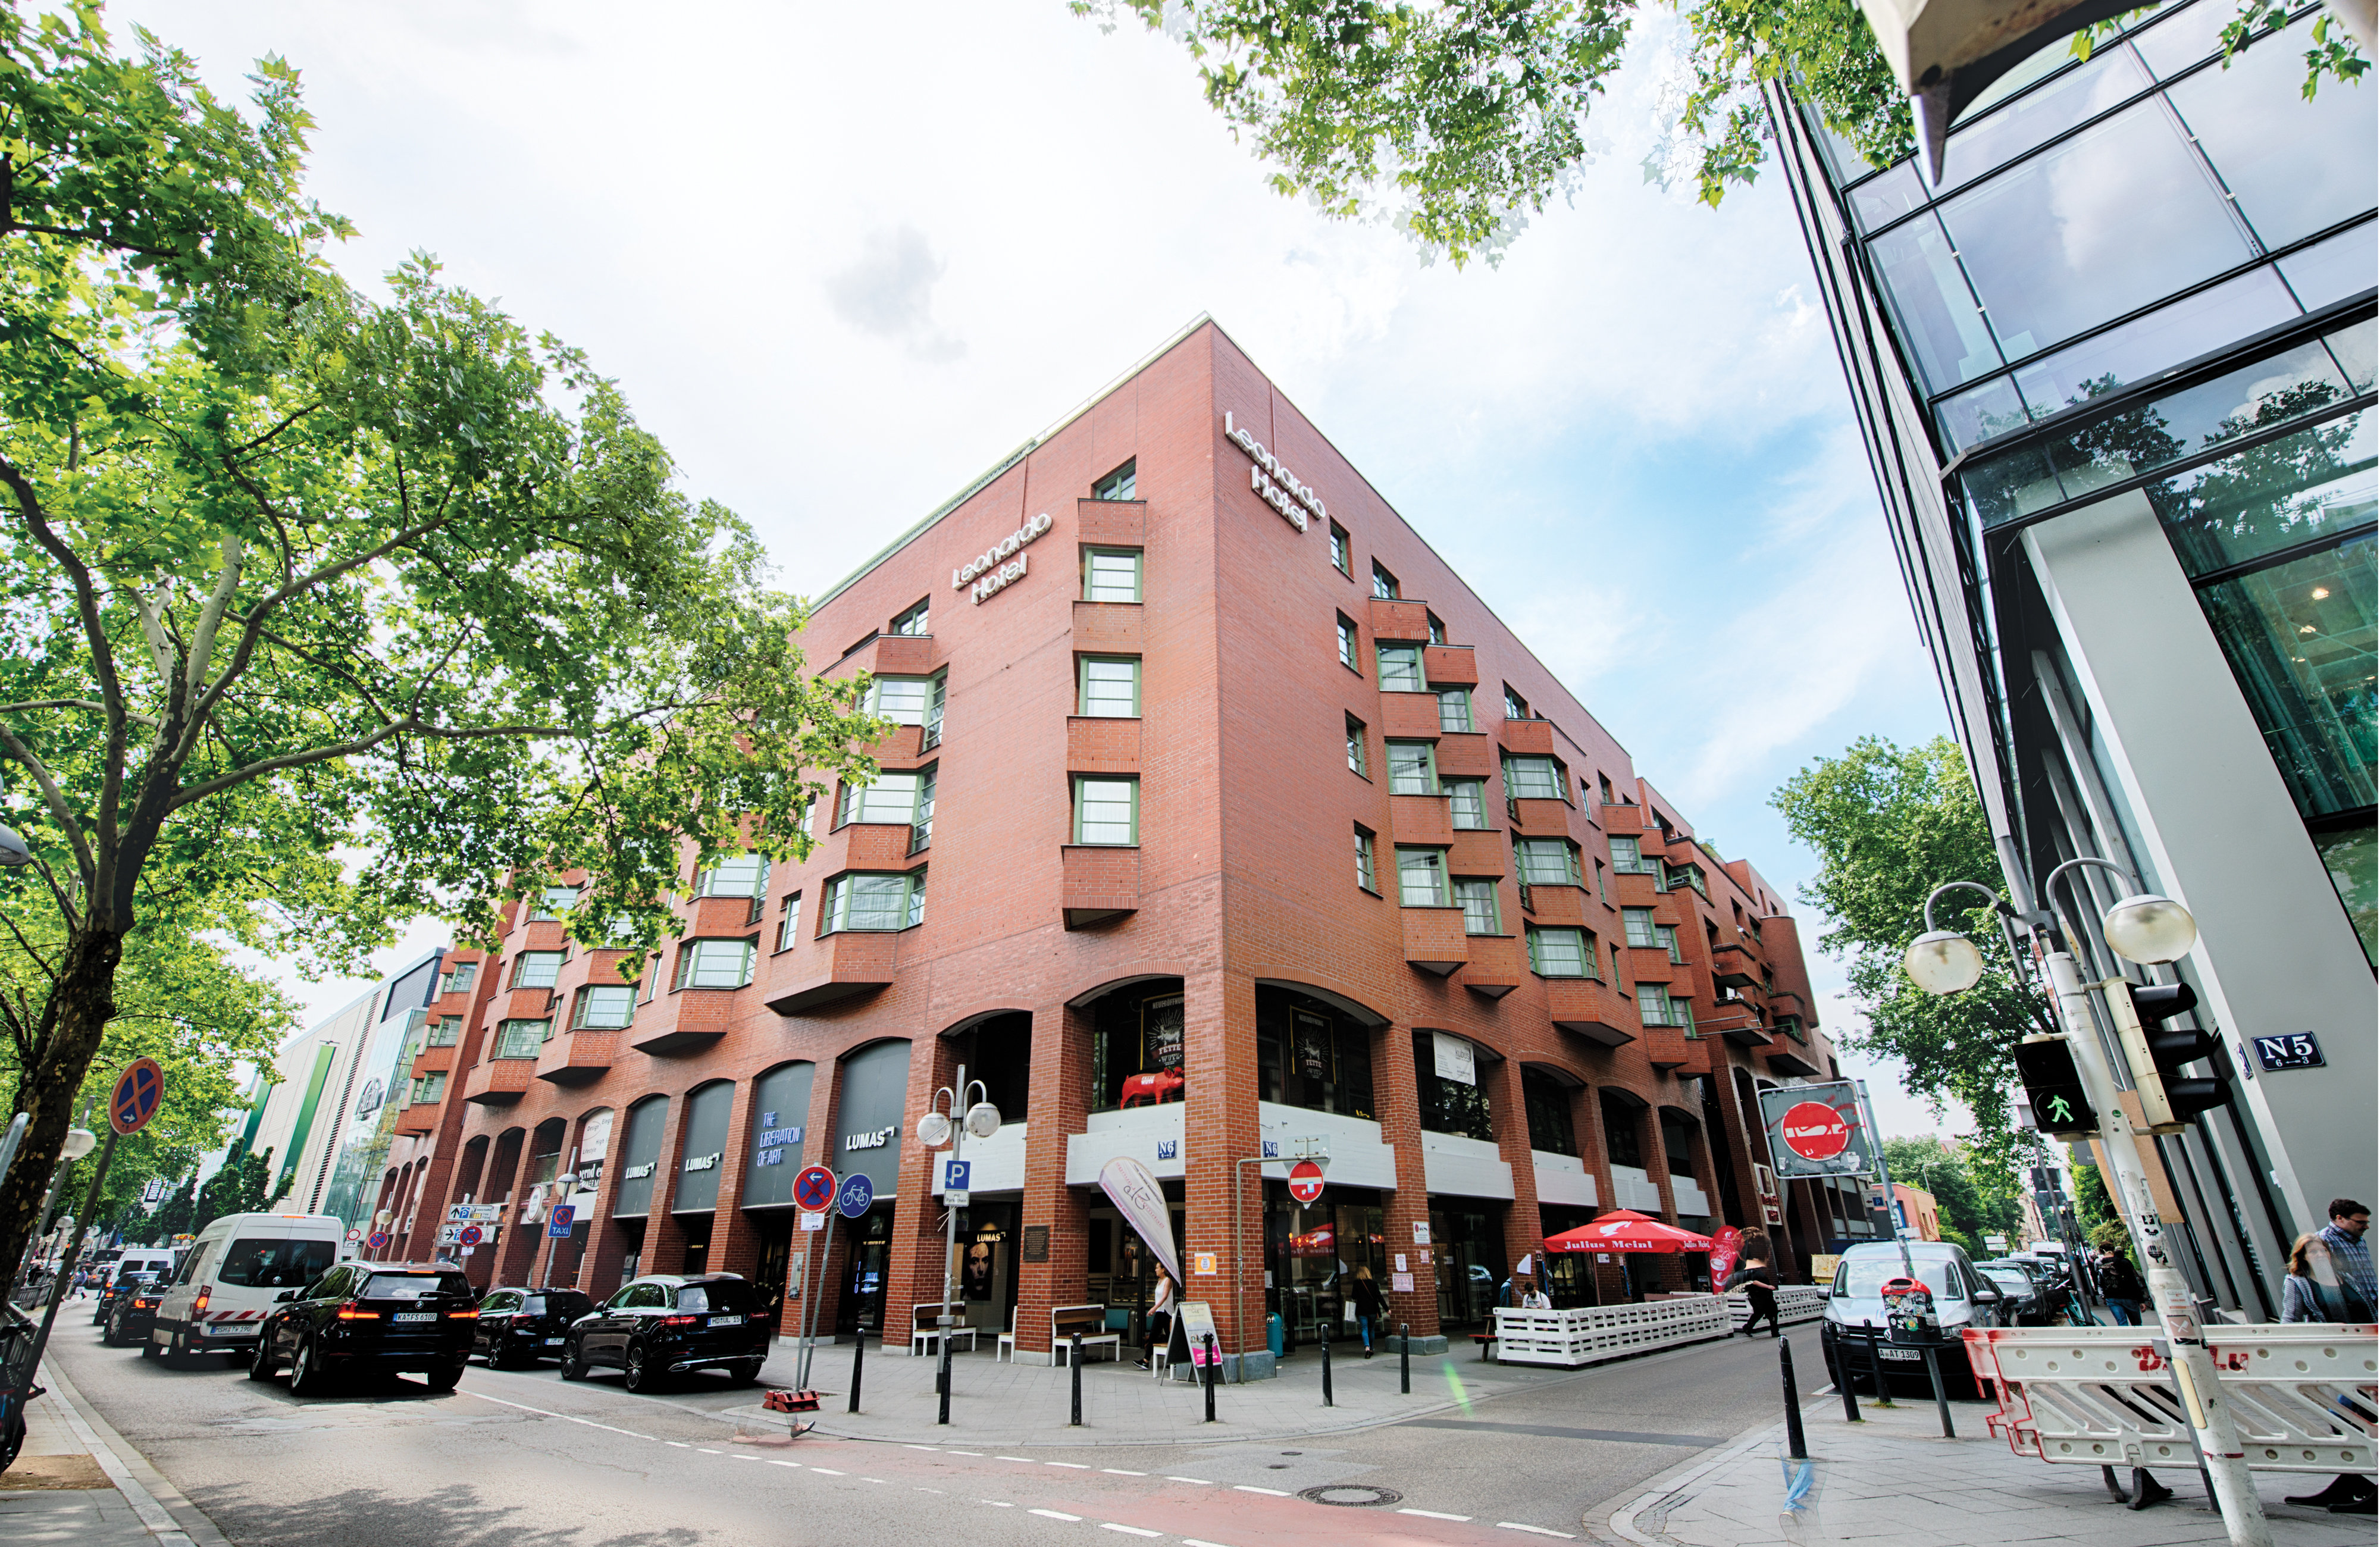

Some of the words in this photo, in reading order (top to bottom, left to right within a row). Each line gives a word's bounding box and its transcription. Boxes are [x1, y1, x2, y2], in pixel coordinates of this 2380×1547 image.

[1226, 411, 1326, 519] Leonardo
[1251, 465, 1307, 532] Hotel
[953, 513, 1053, 590] Leonardo
[971, 552, 1028, 605] Hotel
[1153, 996, 1185, 1009] NEUERÖFFNUN
[1158, 1044, 1181, 1054] FETTE
[1161, 1053, 1180, 1063] WUTZ
[1306, 1060, 1322, 1068] FETTE
[763, 1111, 776, 1128] THE
[759, 1127, 800, 1147] LIBERATION
[845, 1130, 885, 1150] LUMAS
[685, 1155, 713, 1172] LUMAS
[757, 1151, 768, 1167] OF
[767, 1148, 782, 1165] ART
[625, 1164, 649, 1179] LUMAS
[146, 1179, 162, 1200] ATURN
[977, 1233, 1001, 1242] LUMAS
[1564, 1241, 1605, 1250] Julius
[1611, 1240, 1653, 1248] Meinl
[1900, 1351, 1919, 1359] 1309
